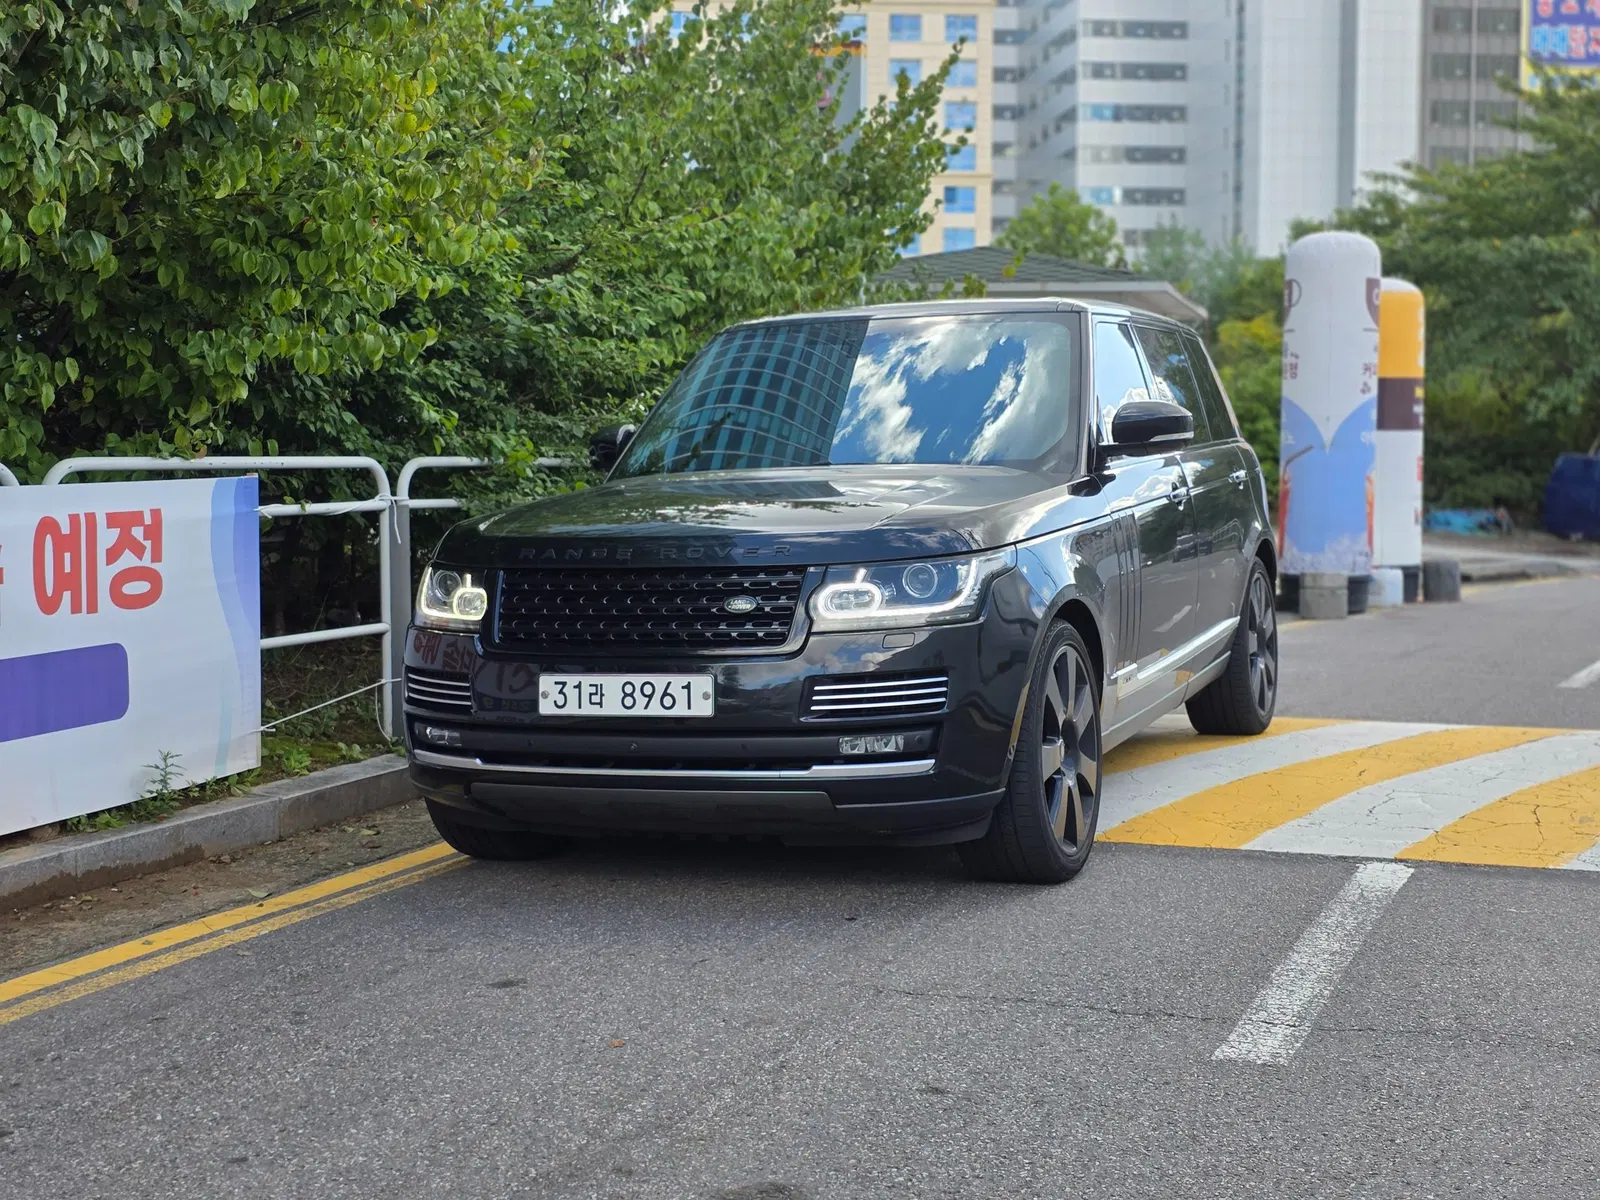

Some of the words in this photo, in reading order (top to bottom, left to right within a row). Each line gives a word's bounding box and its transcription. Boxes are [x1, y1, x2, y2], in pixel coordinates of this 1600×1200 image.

[32, 507, 164, 617] 예정
[518, 547, 634, 561] RANGE
[659, 545, 792, 560] ROVER
[553, 680, 606, 710] 31라
[620, 680, 692, 711] 8961
